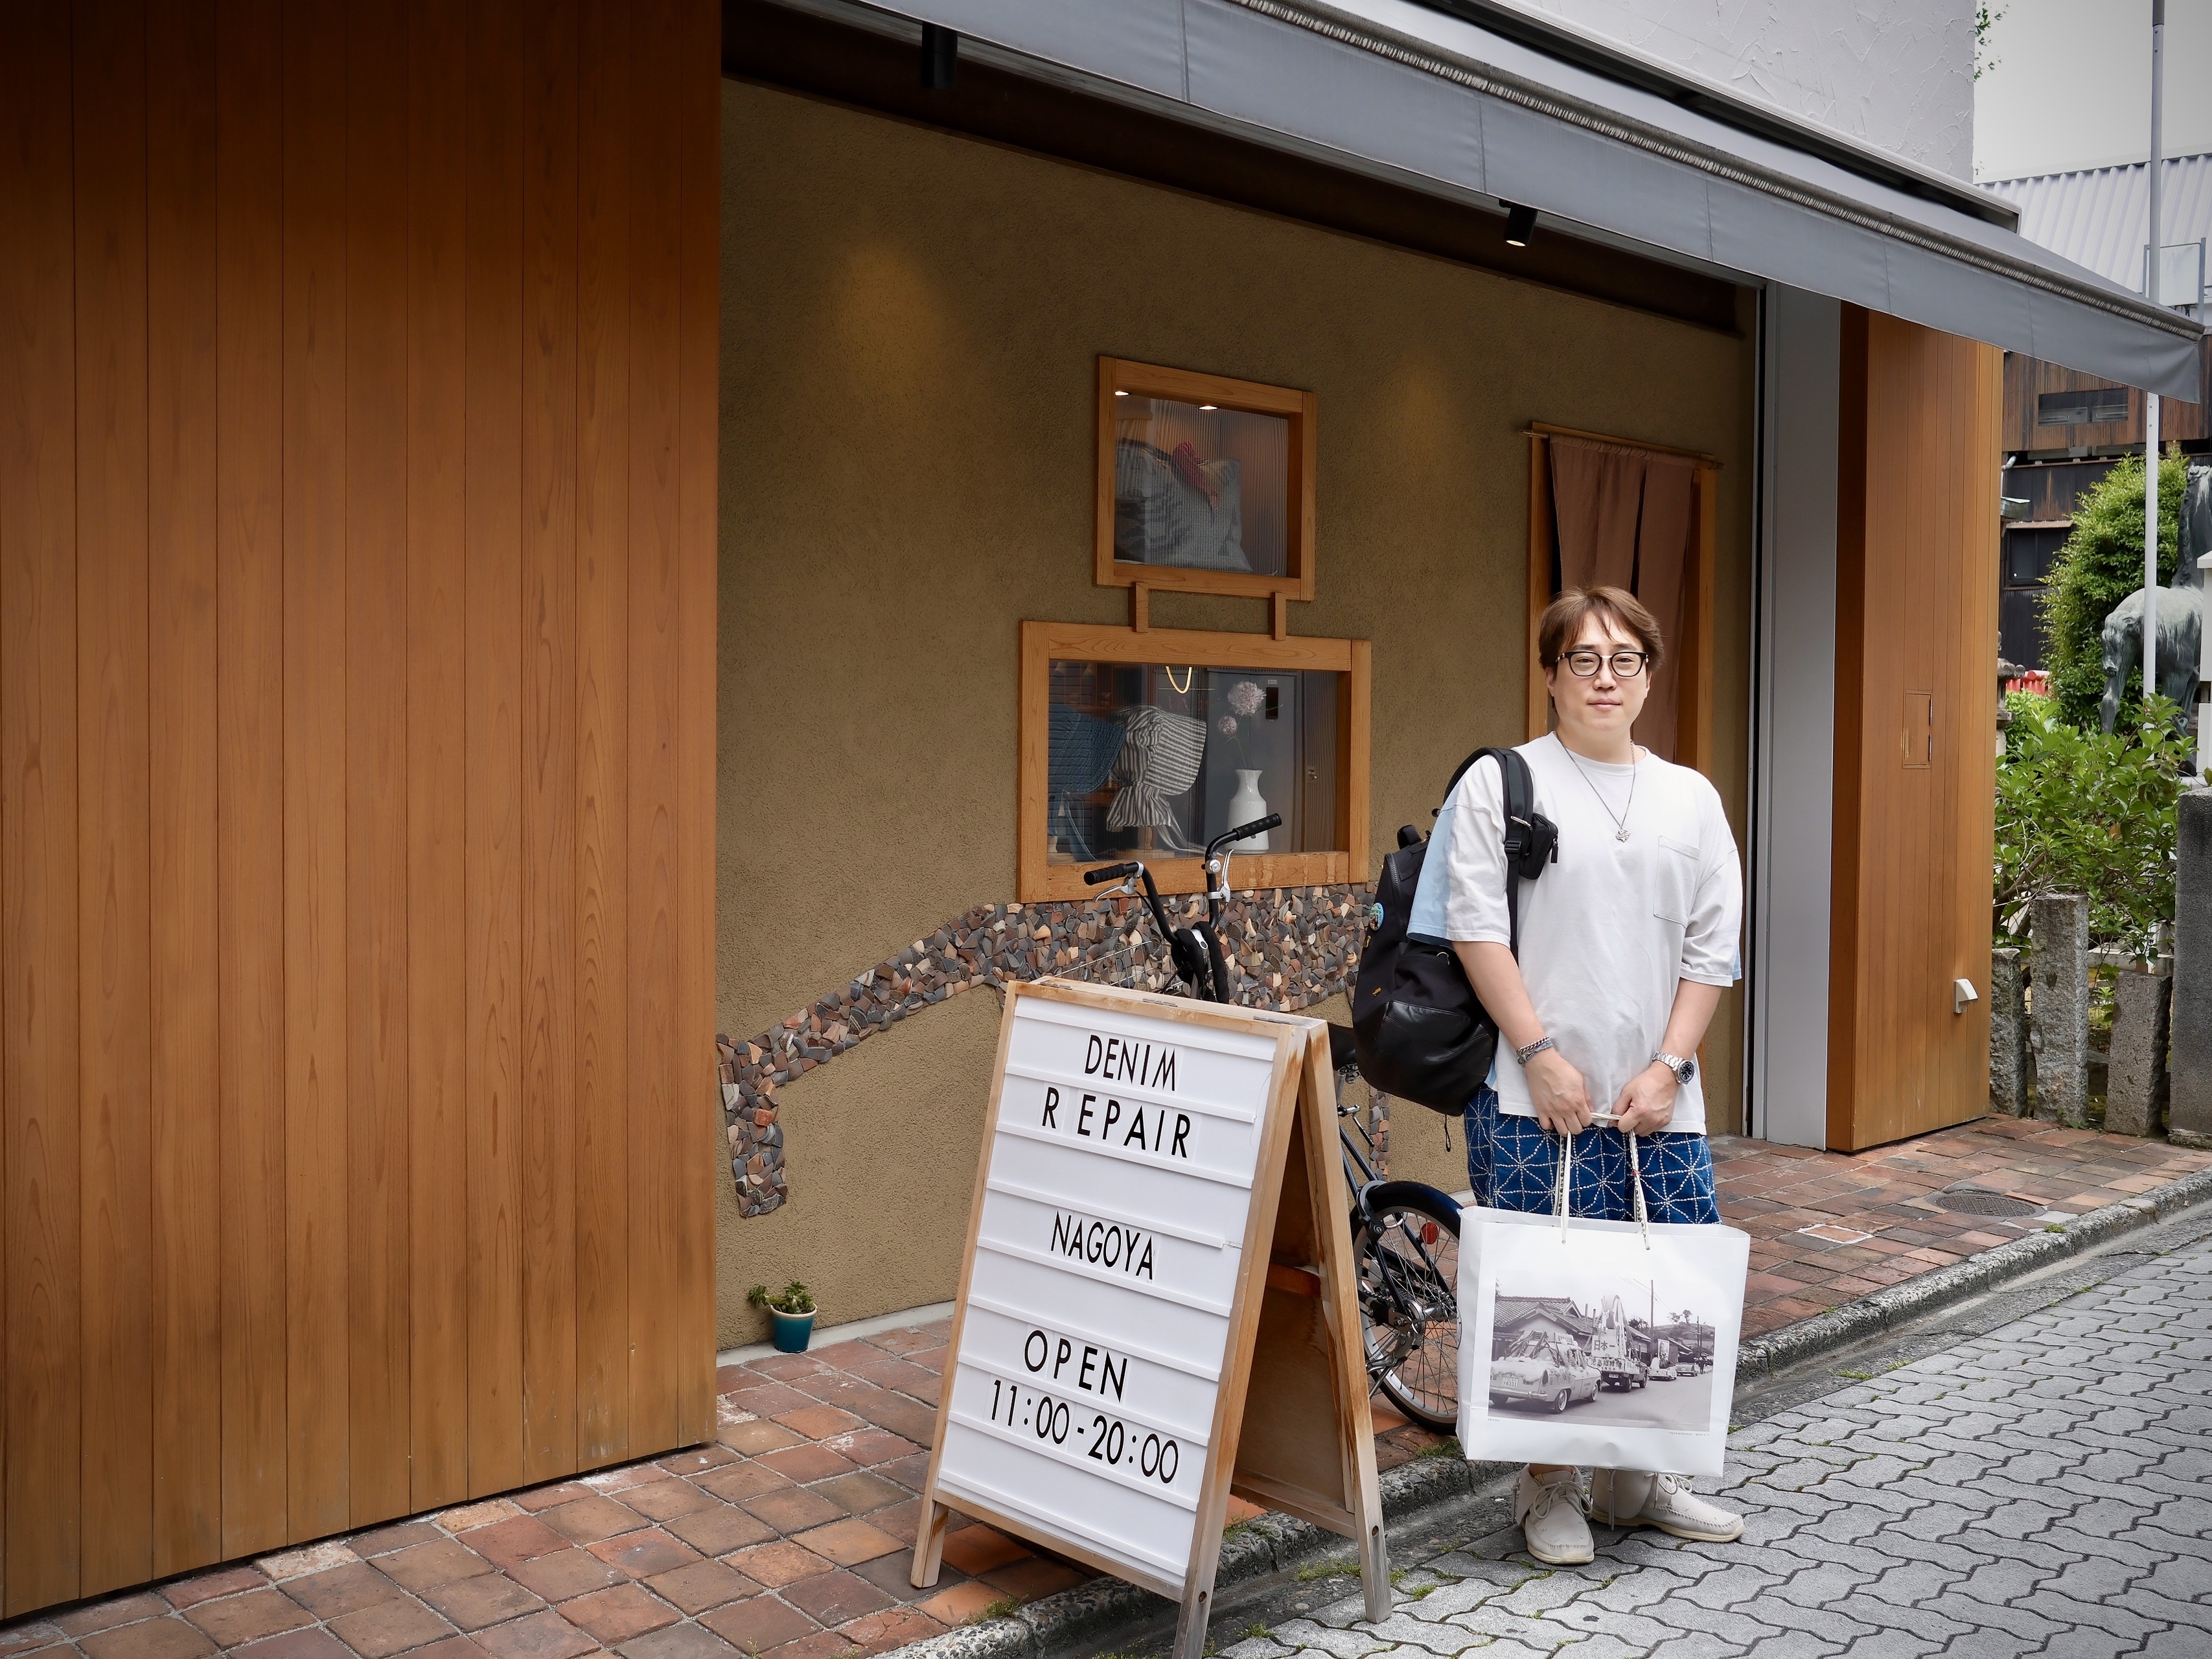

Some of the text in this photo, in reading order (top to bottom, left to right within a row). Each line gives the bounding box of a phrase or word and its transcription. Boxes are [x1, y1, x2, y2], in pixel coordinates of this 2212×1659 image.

[1084, 1034, 1175, 1091] DENIM
[1042, 1087, 1191, 1159] REPAIR
[1050, 1211, 1154, 1281] NAGOYA
[1024, 1330, 1128, 1402] OPEN
[1594, 1340, 1615, 1351] 日本一
